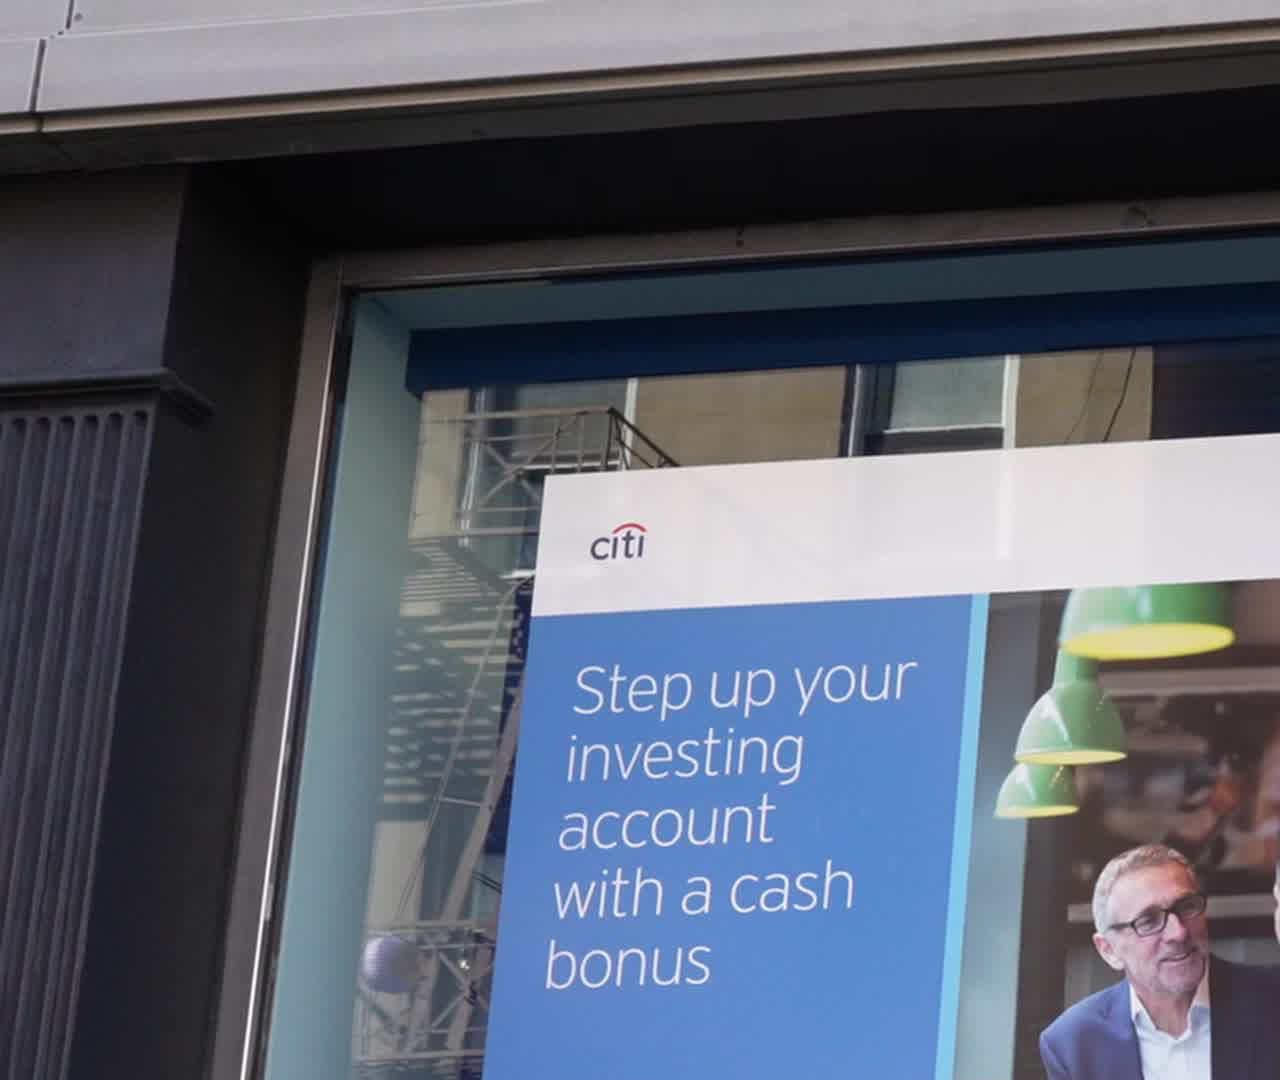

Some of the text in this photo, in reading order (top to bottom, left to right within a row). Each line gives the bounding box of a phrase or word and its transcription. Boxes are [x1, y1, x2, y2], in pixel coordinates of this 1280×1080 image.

[590, 523, 646, 560] citi
[573, 662, 918, 721] Step up your
[568, 728, 803, 785] investing
[559, 793, 776, 850] account
[555, 860, 853, 919] with a cash
[546, 940, 710, 989] bonus
